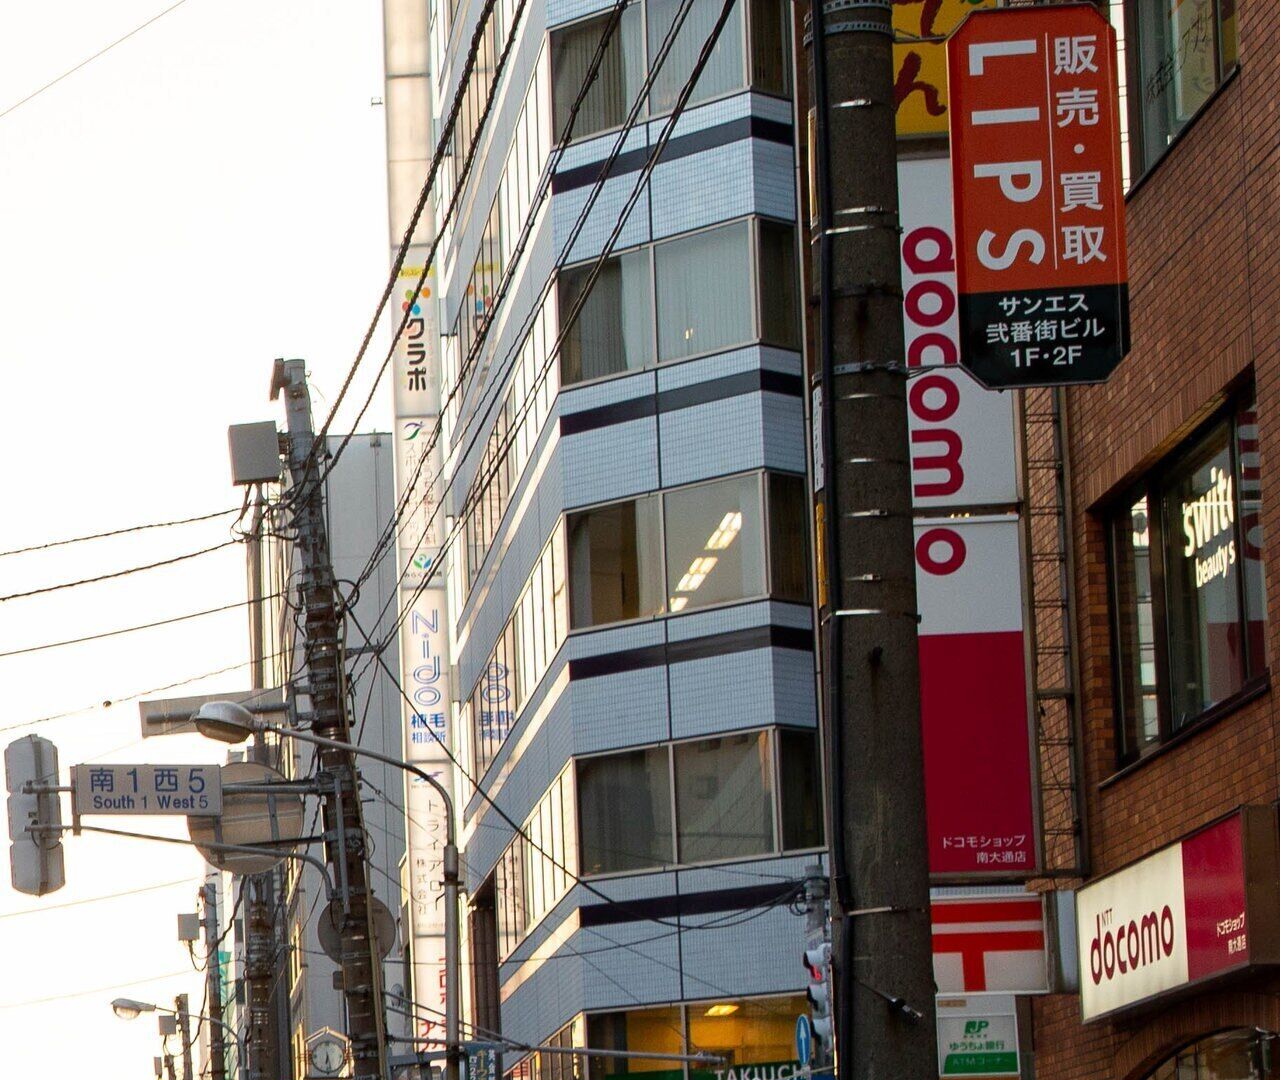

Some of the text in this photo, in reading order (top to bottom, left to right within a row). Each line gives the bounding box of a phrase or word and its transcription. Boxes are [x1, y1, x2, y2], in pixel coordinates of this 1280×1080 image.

[968, 39, 1045, 271] LIPS
[1053, 36, 1106, 265] 販売・買取
[998, 294, 1089, 315] サンエス
[986, 318, 1105, 343] 弐番街ビル
[93, 796, 208, 809] South 1 West 5
[942, 835, 1026, 849] ドコモショップ
[976, 851, 1027, 864] 南大通店
[1100, 908, 1113, 926] NTT
[1090, 904, 1174, 985] docomo
